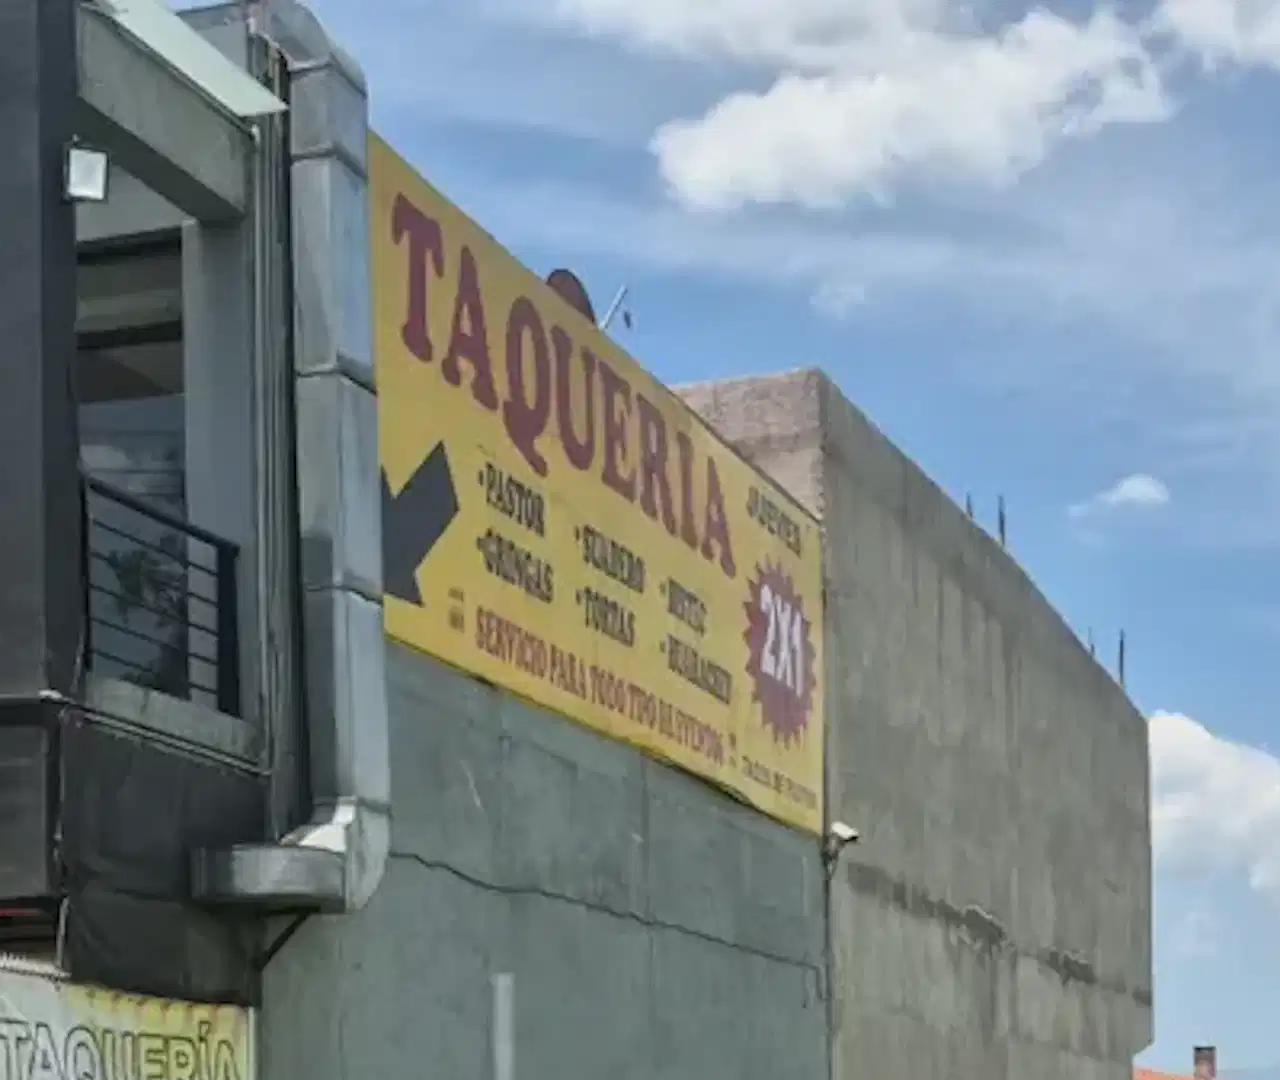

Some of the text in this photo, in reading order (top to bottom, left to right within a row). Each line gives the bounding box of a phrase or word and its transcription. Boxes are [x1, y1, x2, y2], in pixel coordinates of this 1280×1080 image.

[391, 191, 737, 579] TAQUERIA
[486, 462, 545, 537] PASTOR
[483, 527, 554, 604] GRINGAS
[476, 604, 548, 680] SERVICIO
[550, 643, 586, 701] PARA
[760, 583, 804, 698] 2X1
